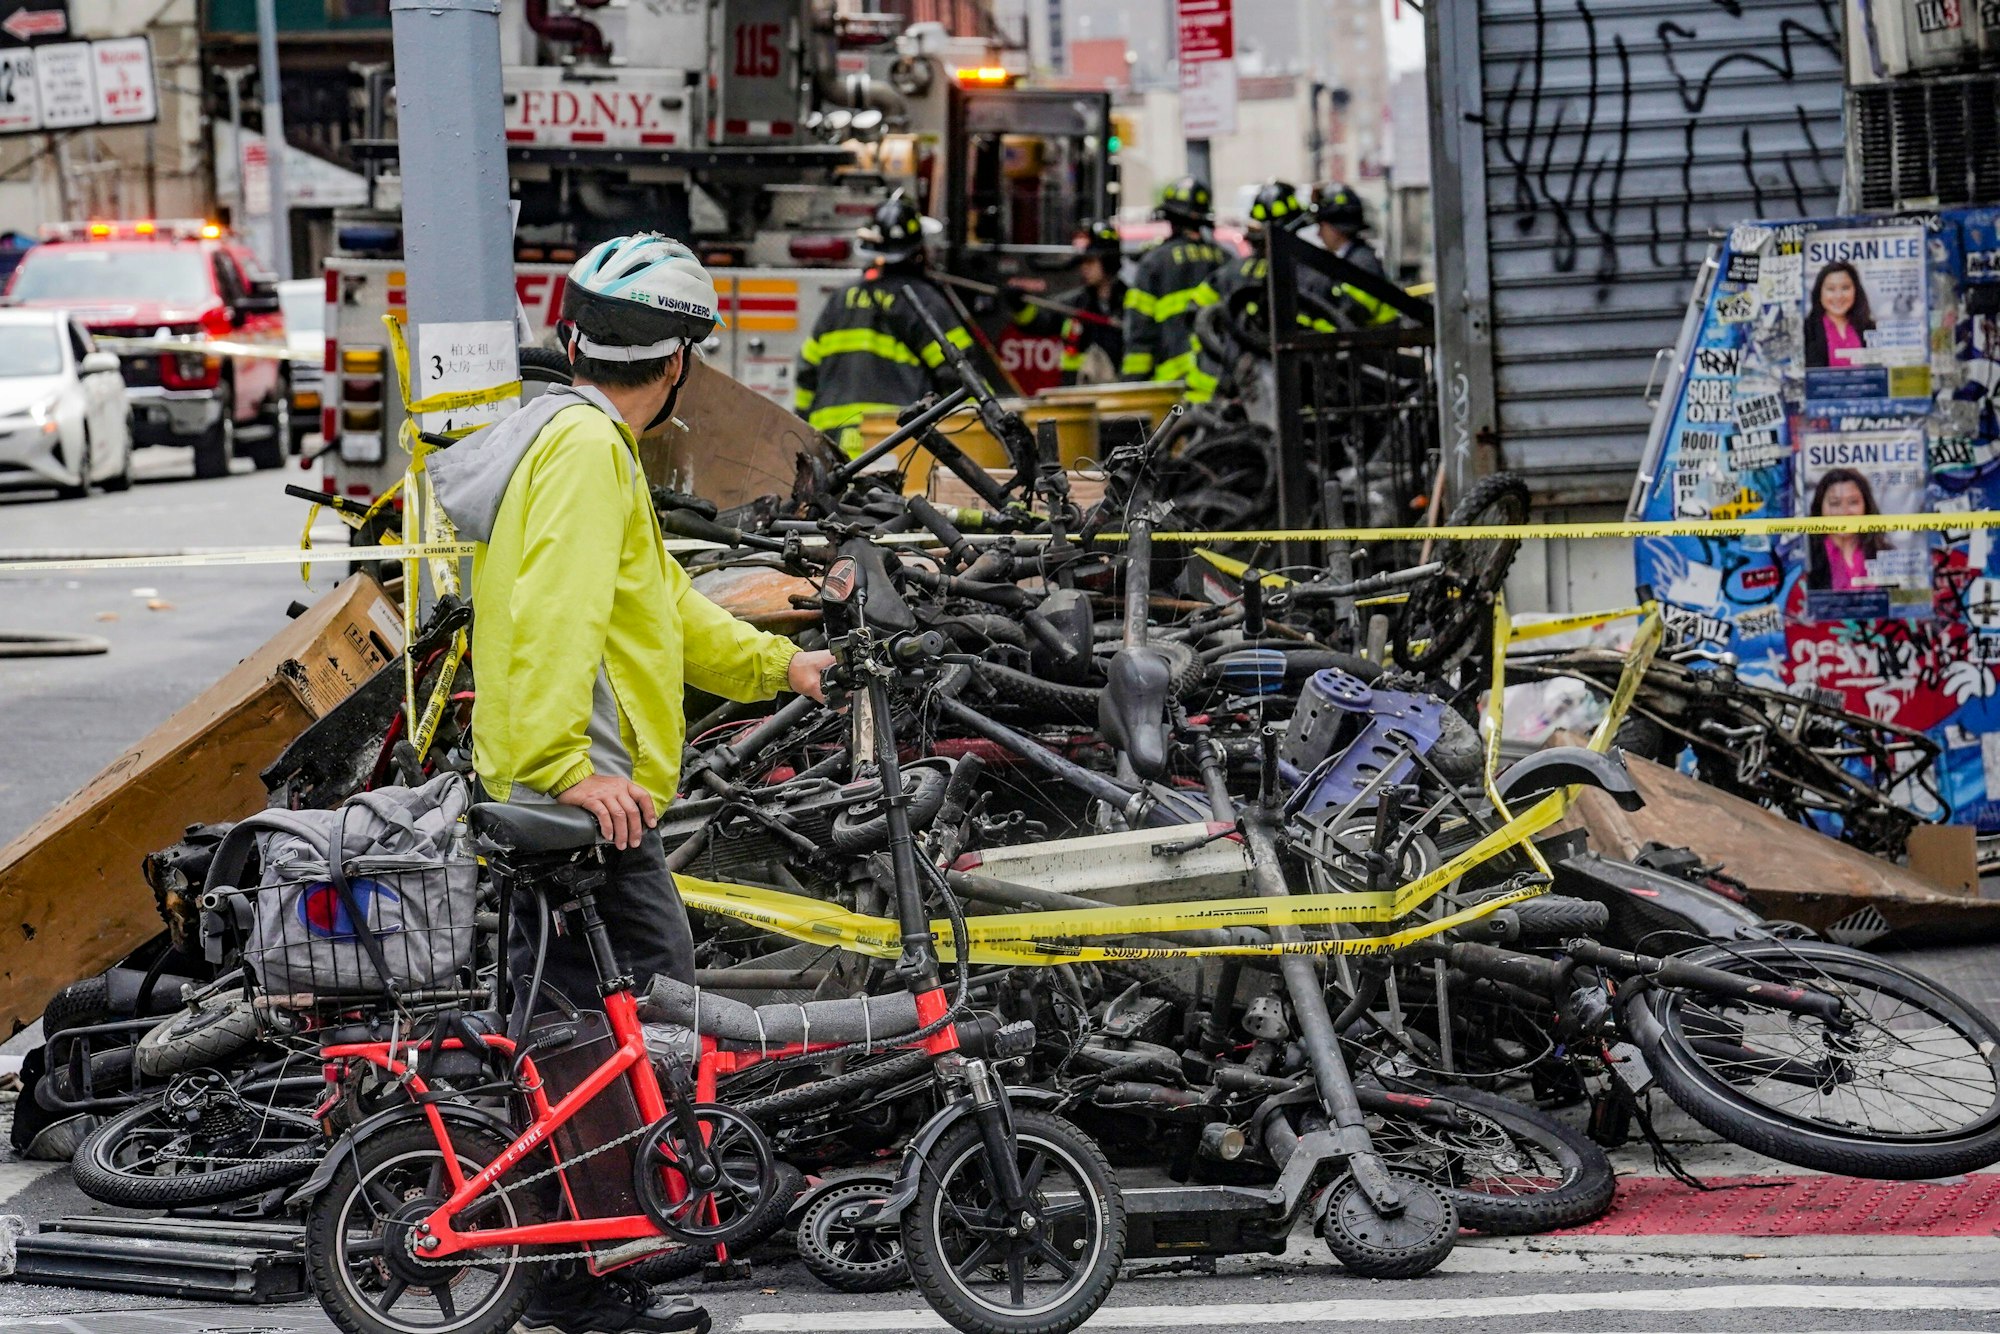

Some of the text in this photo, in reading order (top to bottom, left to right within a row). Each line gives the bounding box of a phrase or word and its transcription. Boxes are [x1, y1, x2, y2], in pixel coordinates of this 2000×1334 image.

[735, 24, 781, 78] 115
[521, 90, 659, 128] F.D.N.Y.
[1810, 239, 1920, 263] SUSAN LEE
[658, 294, 710, 318] VISION ZERO
[451, 343, 489, 356] 柏文租
[431, 355, 444, 380] 3
[1687, 379, 1732, 403] SORE
[1687, 403, 1733, 423] ONE
[1810, 443, 1878, 465] SUSAN
[1882, 442, 1918, 463] LEE
[424, 546, 475, 555] CRIME SC
[1103, 945, 1143, 959] CROSS
[483, 1127, 544, 1182] FLY E-BIKE
